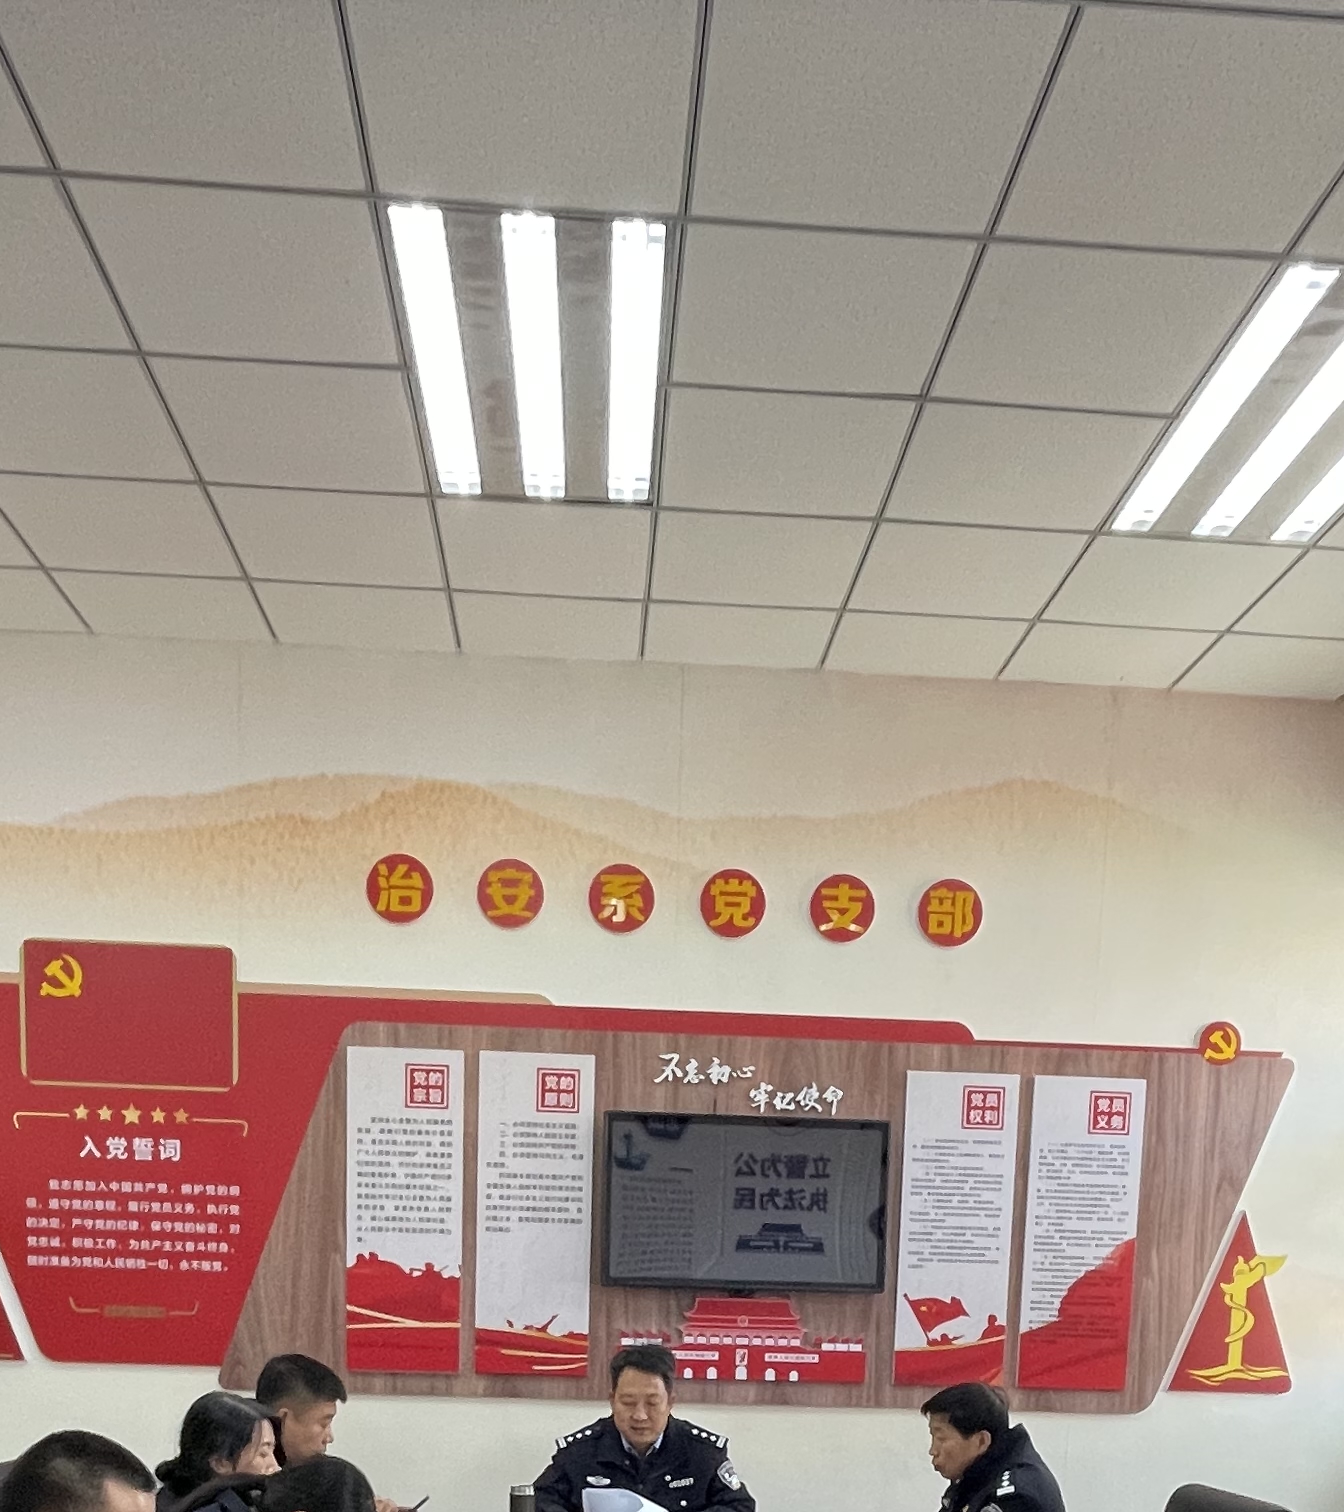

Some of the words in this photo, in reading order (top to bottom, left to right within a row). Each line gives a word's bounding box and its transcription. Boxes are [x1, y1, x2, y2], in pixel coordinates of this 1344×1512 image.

[653, 1053, 756, 1085] 不忘初心
[749, 1081, 844, 1115] 牢记使命
[78, 1135, 182, 1162] 入党誓词
